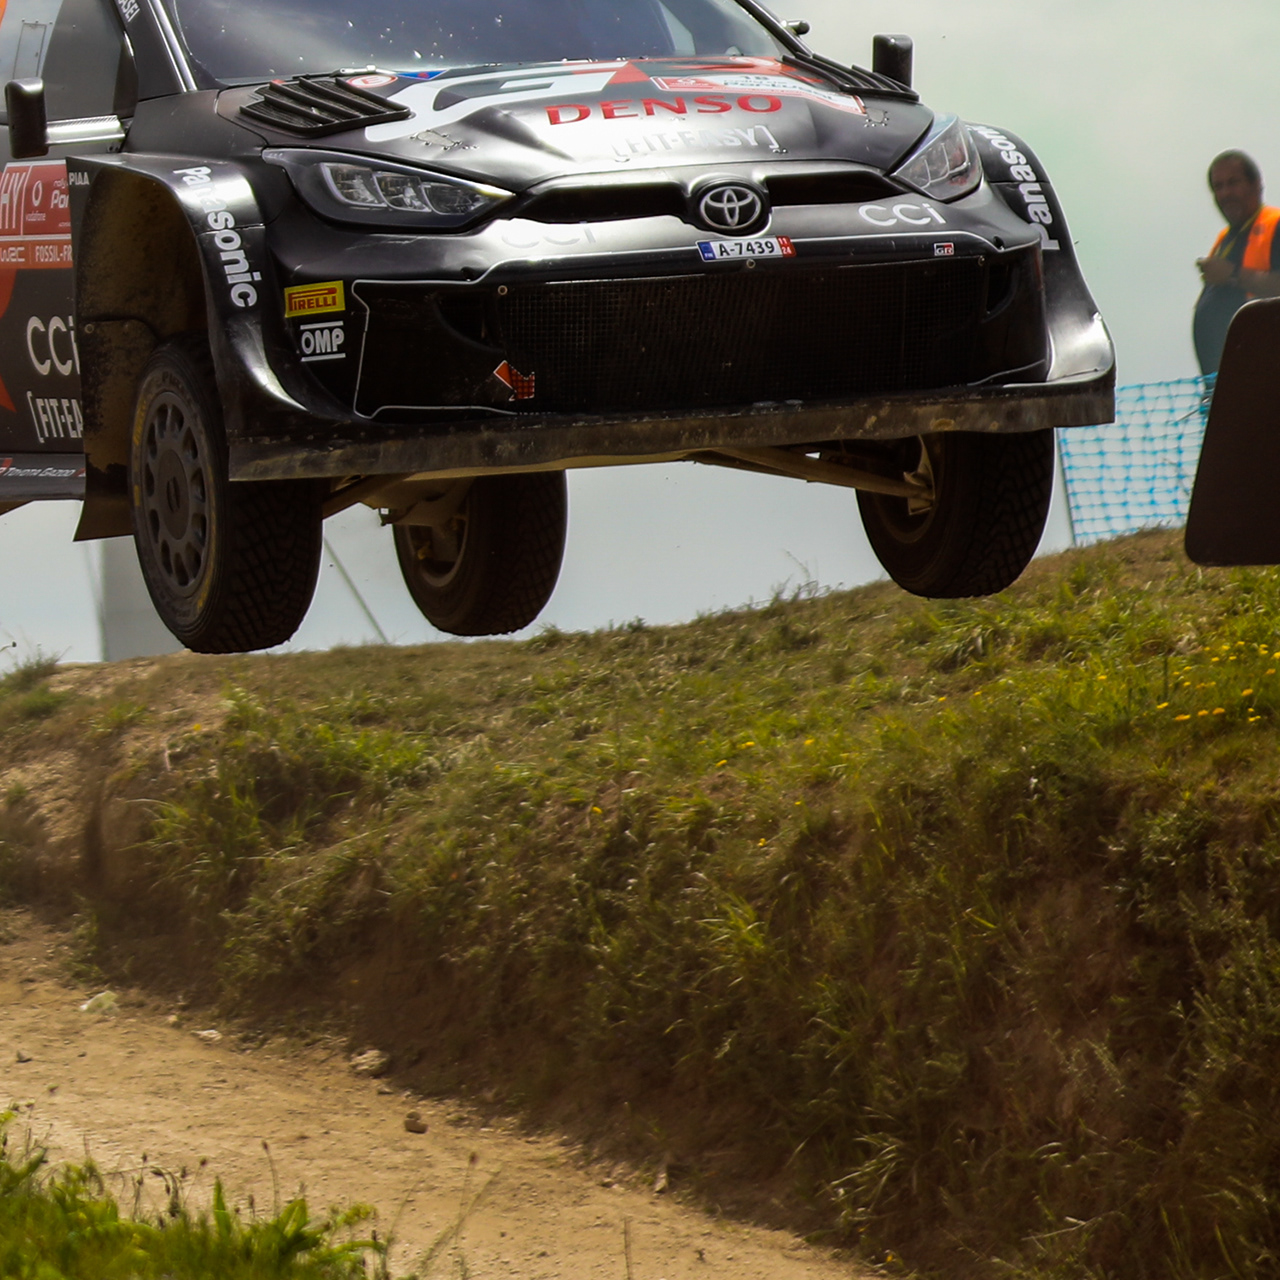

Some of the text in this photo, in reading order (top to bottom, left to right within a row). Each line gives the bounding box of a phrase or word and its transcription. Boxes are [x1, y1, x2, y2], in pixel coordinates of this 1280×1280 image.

[543, 94, 782, 125] DENSO
[68, 171, 90, 186] PIAA
[719, 240, 775, 256] A-7439
[289, 287, 338, 312] PIRELLI
[301, 328, 345, 355] OMP
